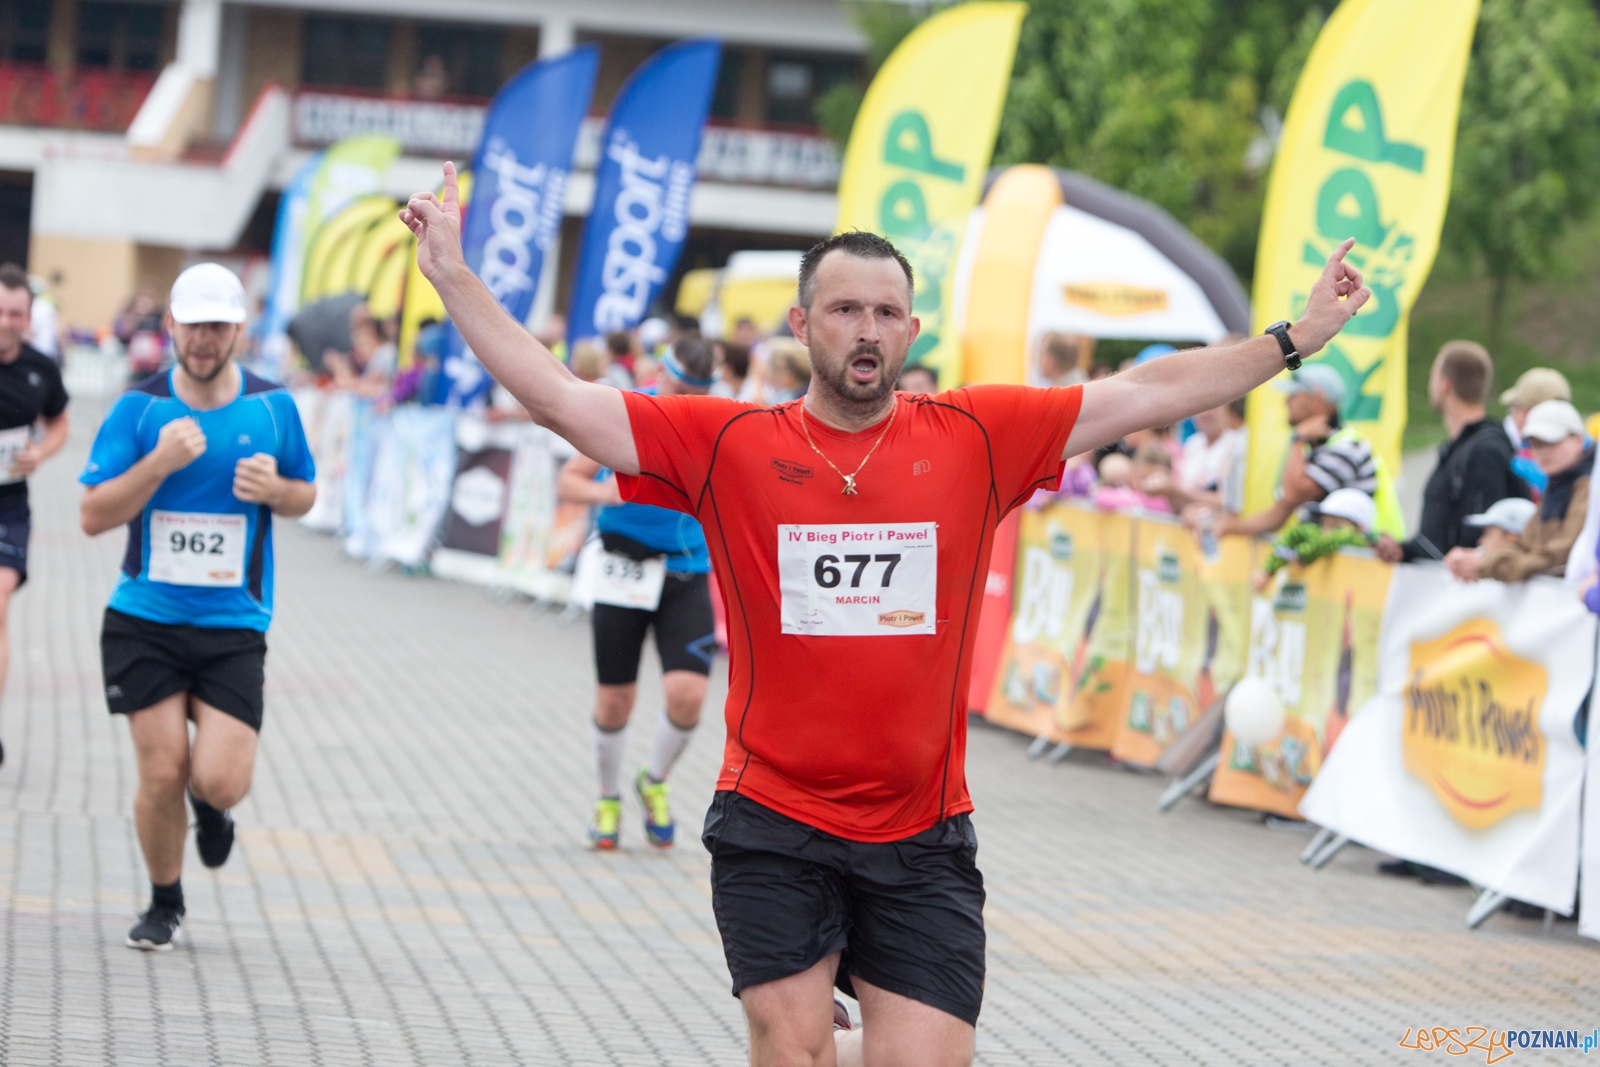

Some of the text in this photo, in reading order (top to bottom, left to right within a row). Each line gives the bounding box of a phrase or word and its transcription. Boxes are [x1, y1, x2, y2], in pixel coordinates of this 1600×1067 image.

[169, 530, 225, 555] 962
[788, 529, 928, 544] IV Bieg Piotr i Paweł
[814, 554, 901, 589] 677
[835, 595, 881, 605] MARCIN
